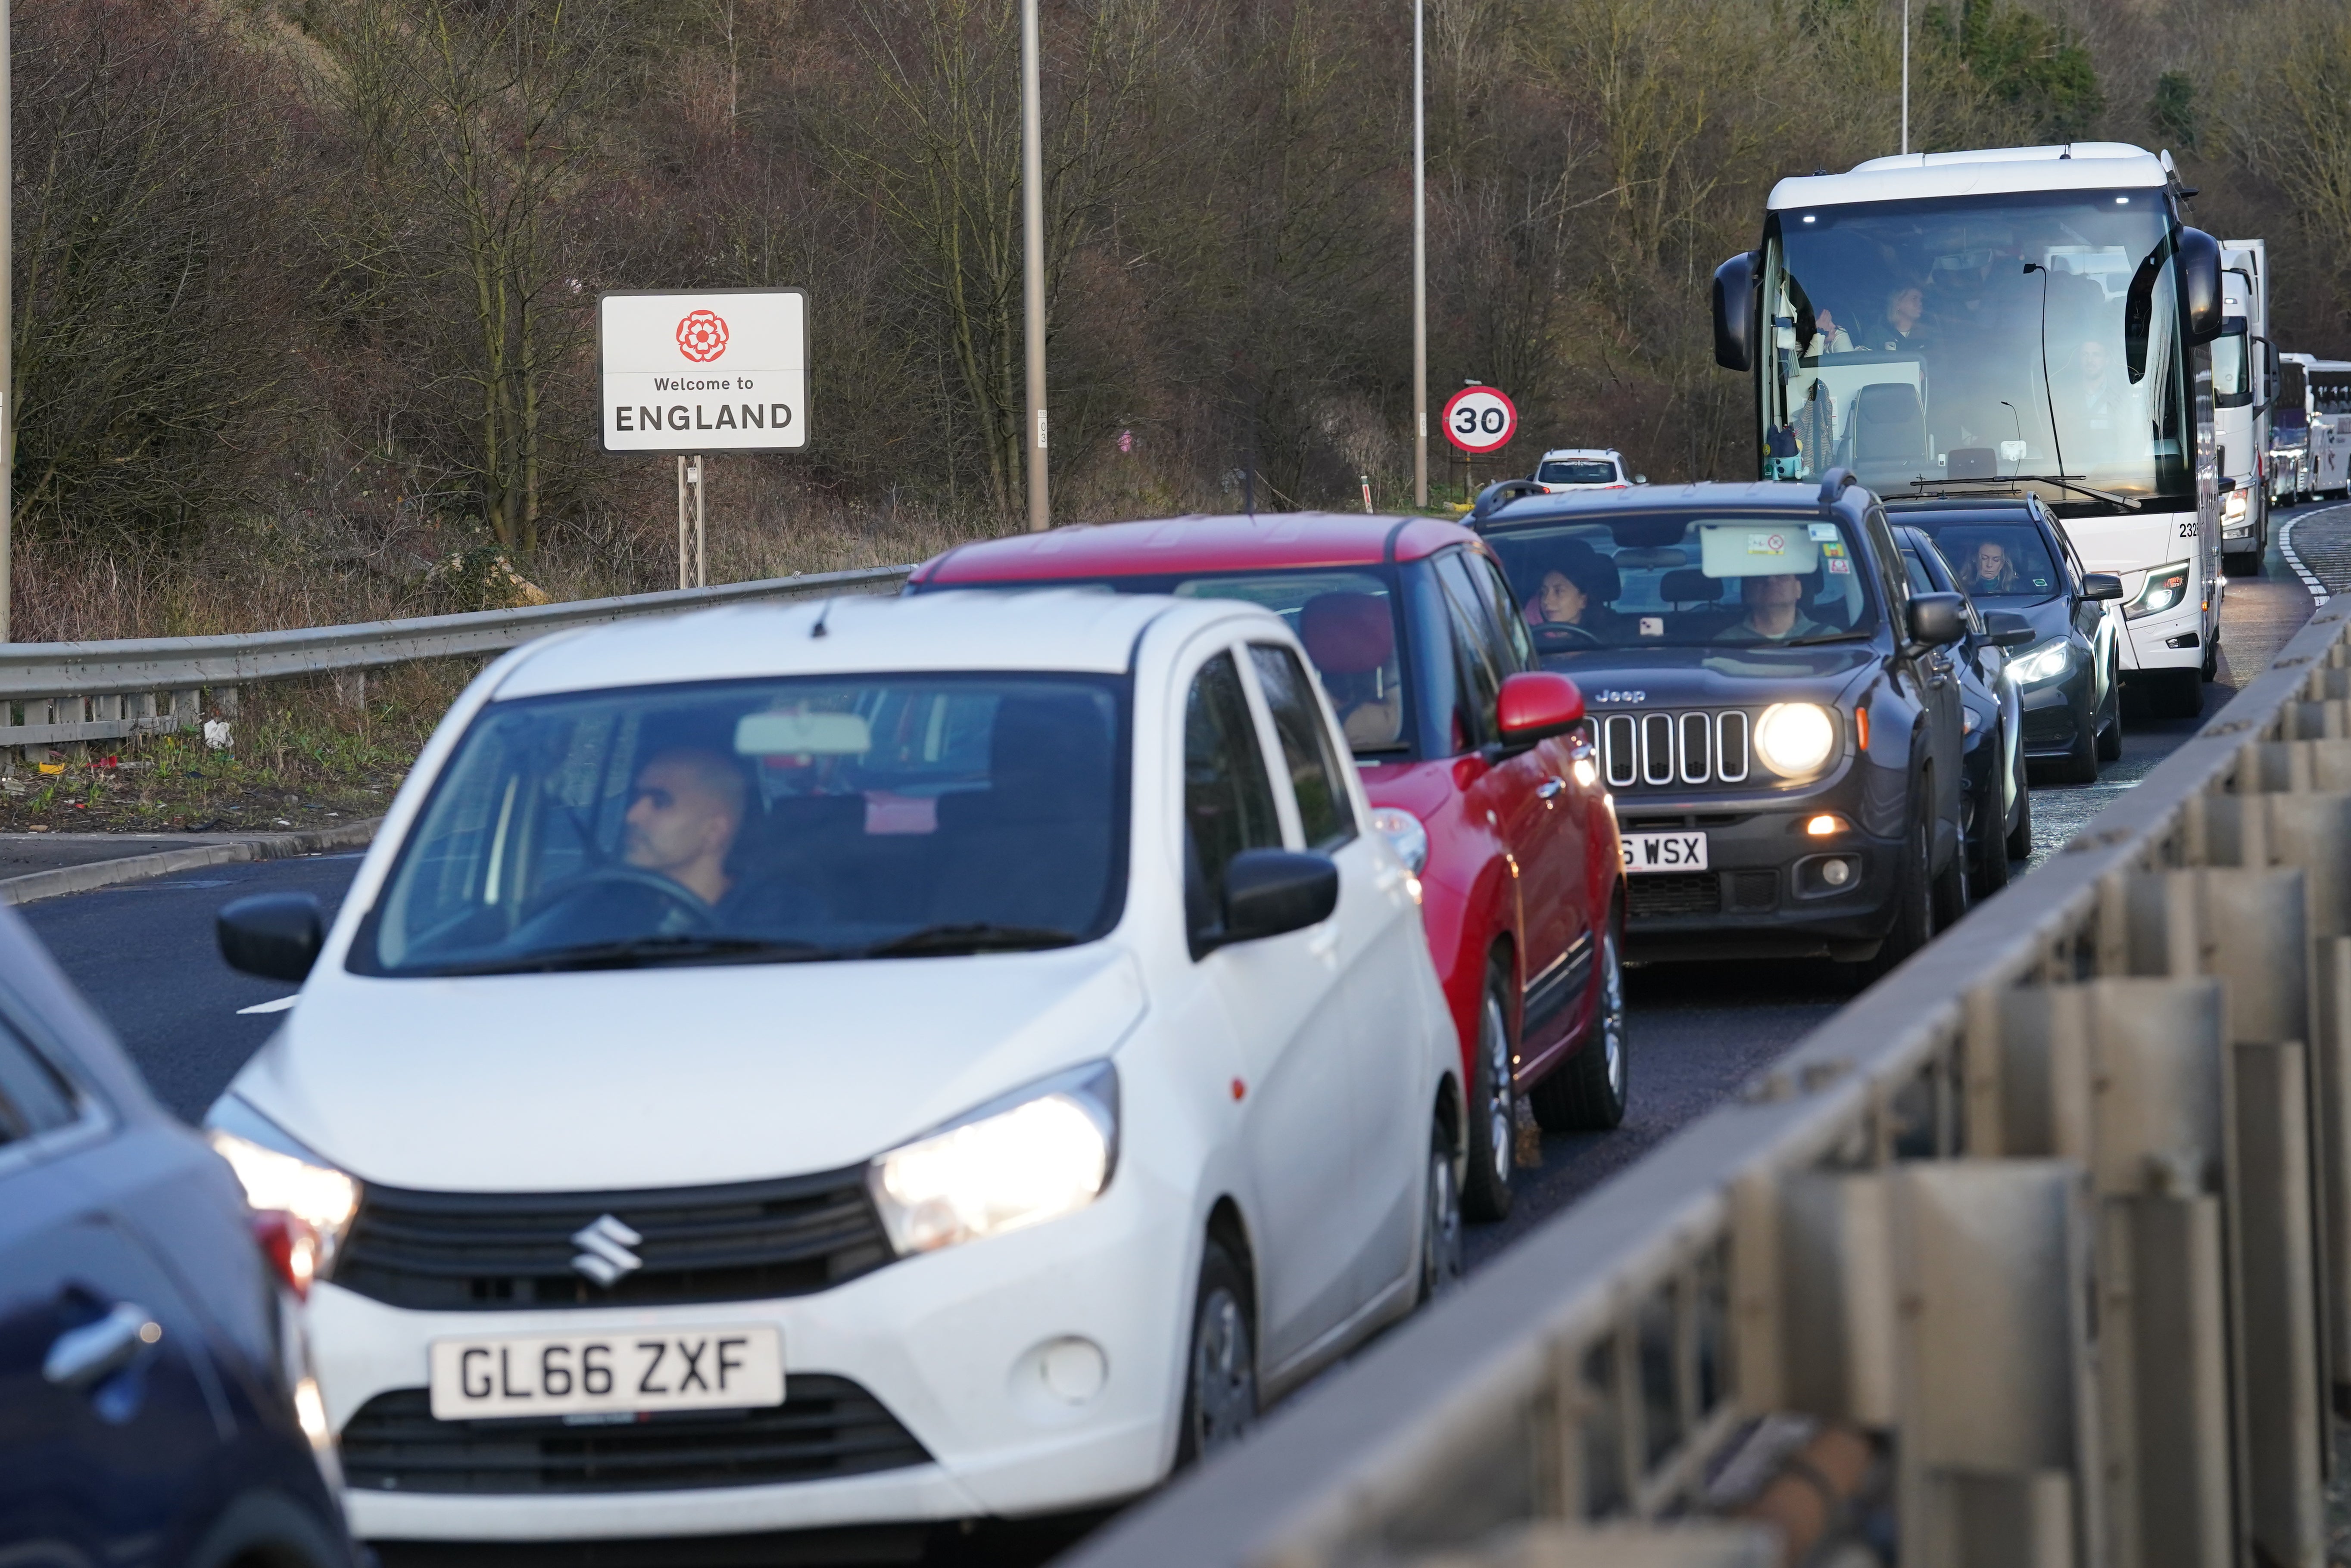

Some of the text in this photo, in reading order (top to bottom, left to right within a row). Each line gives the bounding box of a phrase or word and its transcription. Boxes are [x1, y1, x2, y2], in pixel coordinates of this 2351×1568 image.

[654, 377, 753, 391] Welcome to
[616, 404, 792, 431] ENGLAND
[1455, 407, 1505, 434] 30
[1595, 689, 1646, 703] Jeep
[1644, 838, 1699, 864] WSX
[461, 1337, 749, 1400] GL66 ZXF
